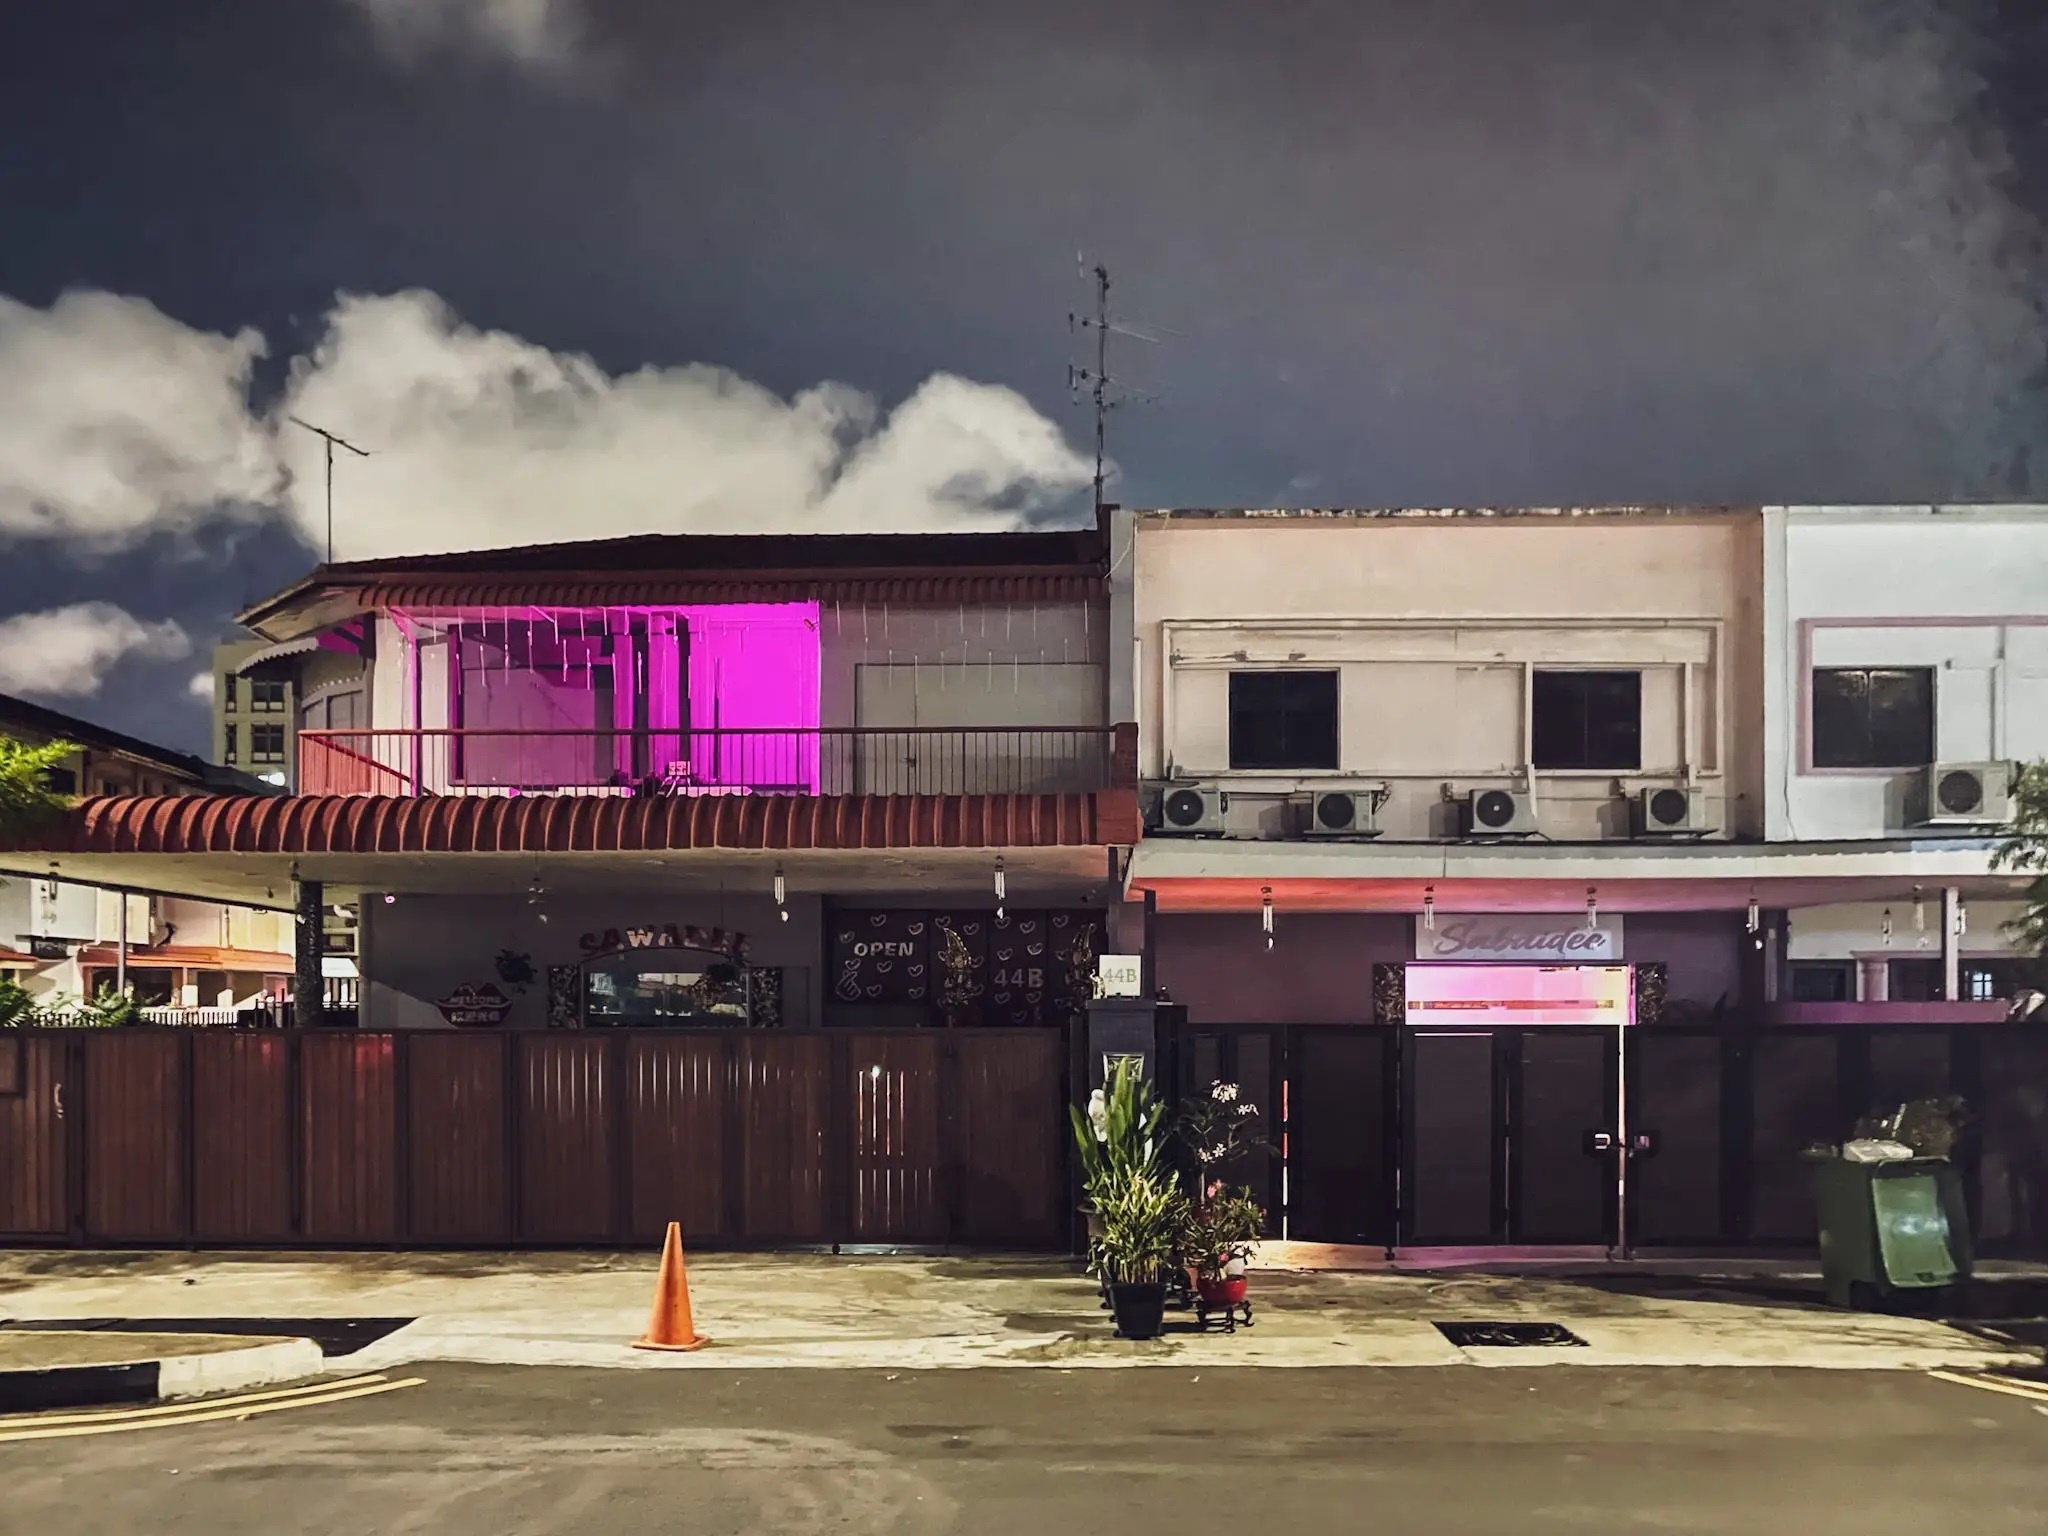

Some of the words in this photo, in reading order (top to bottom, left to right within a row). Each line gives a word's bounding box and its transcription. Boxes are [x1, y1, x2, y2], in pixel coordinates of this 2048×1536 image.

[853, 942, 914, 956] OPEN
[994, 968, 1043, 988] 44B
[1104, 968, 1137, 983] 44B
